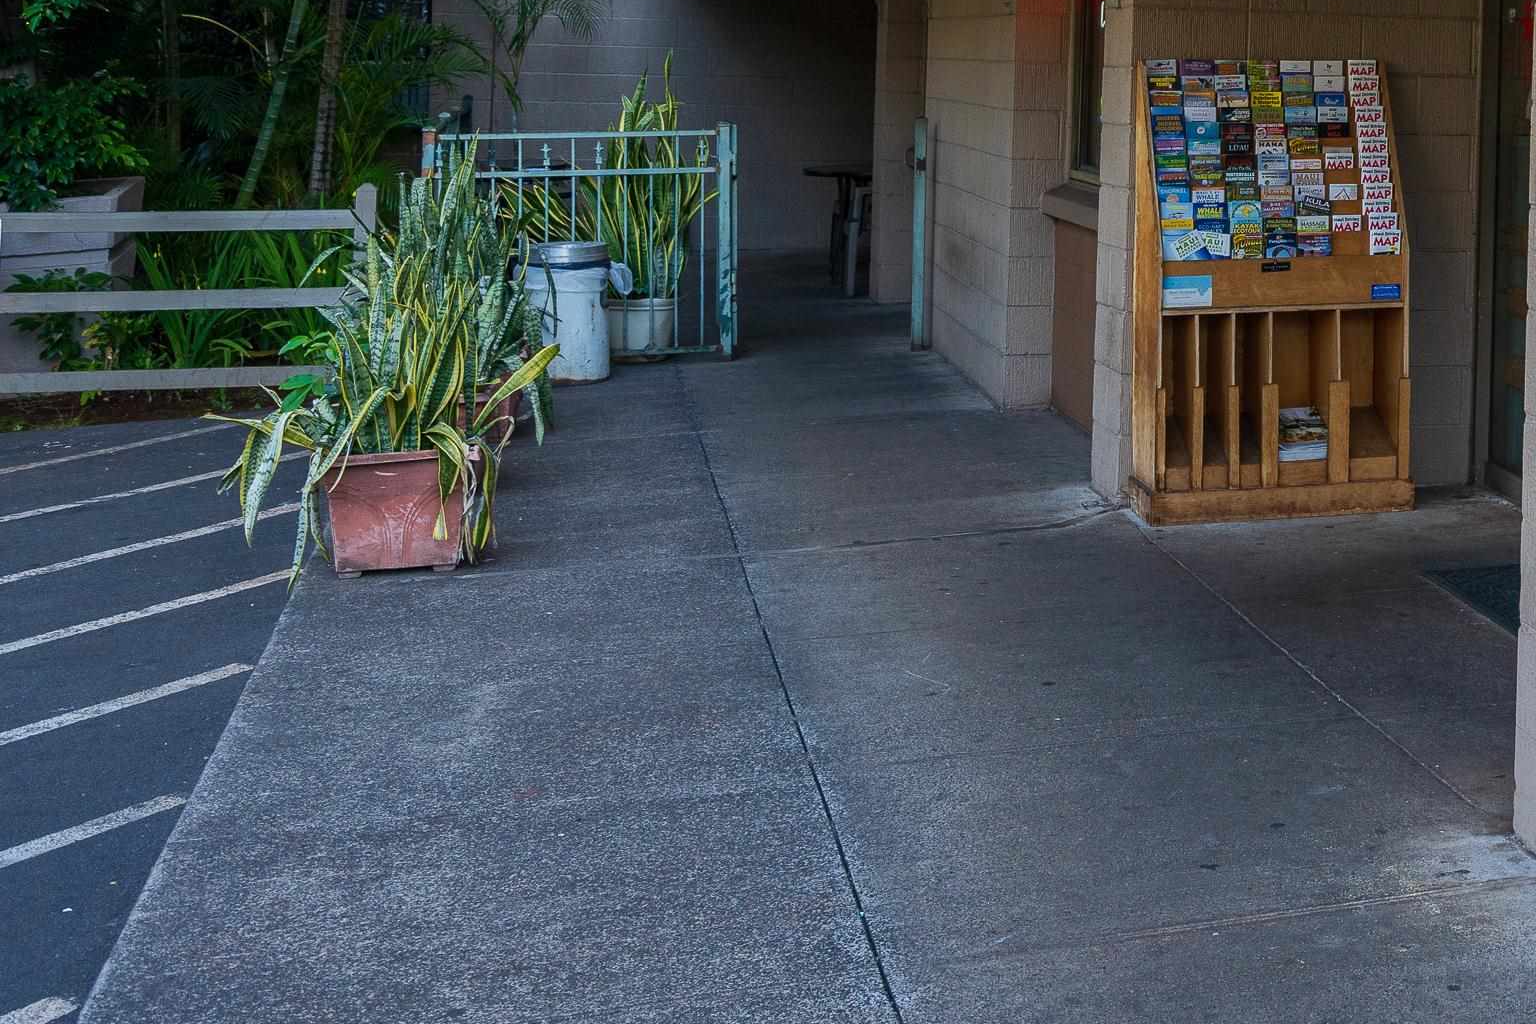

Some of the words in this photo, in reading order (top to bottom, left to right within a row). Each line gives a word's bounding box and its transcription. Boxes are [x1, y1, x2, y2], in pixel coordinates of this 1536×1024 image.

[1350, 67, 1374, 75] MAP
[1353, 82, 1377, 91] MAP
[1351, 97, 1376, 107] MAP
[1357, 113, 1381, 122] MAP
[1360, 129, 1384, 137] MAP
[1362, 144, 1386, 152] MAP
[1327, 160, 1352, 169] MAP
[1362, 160, 1386, 168] MAP
[1363, 174, 1387, 183] MAP
[1367, 190, 1391, 199] MAP
[1335, 222, 1359, 231] MAP
[1370, 220, 1395, 229] MAP
[1374, 237, 1399, 245] MAP
